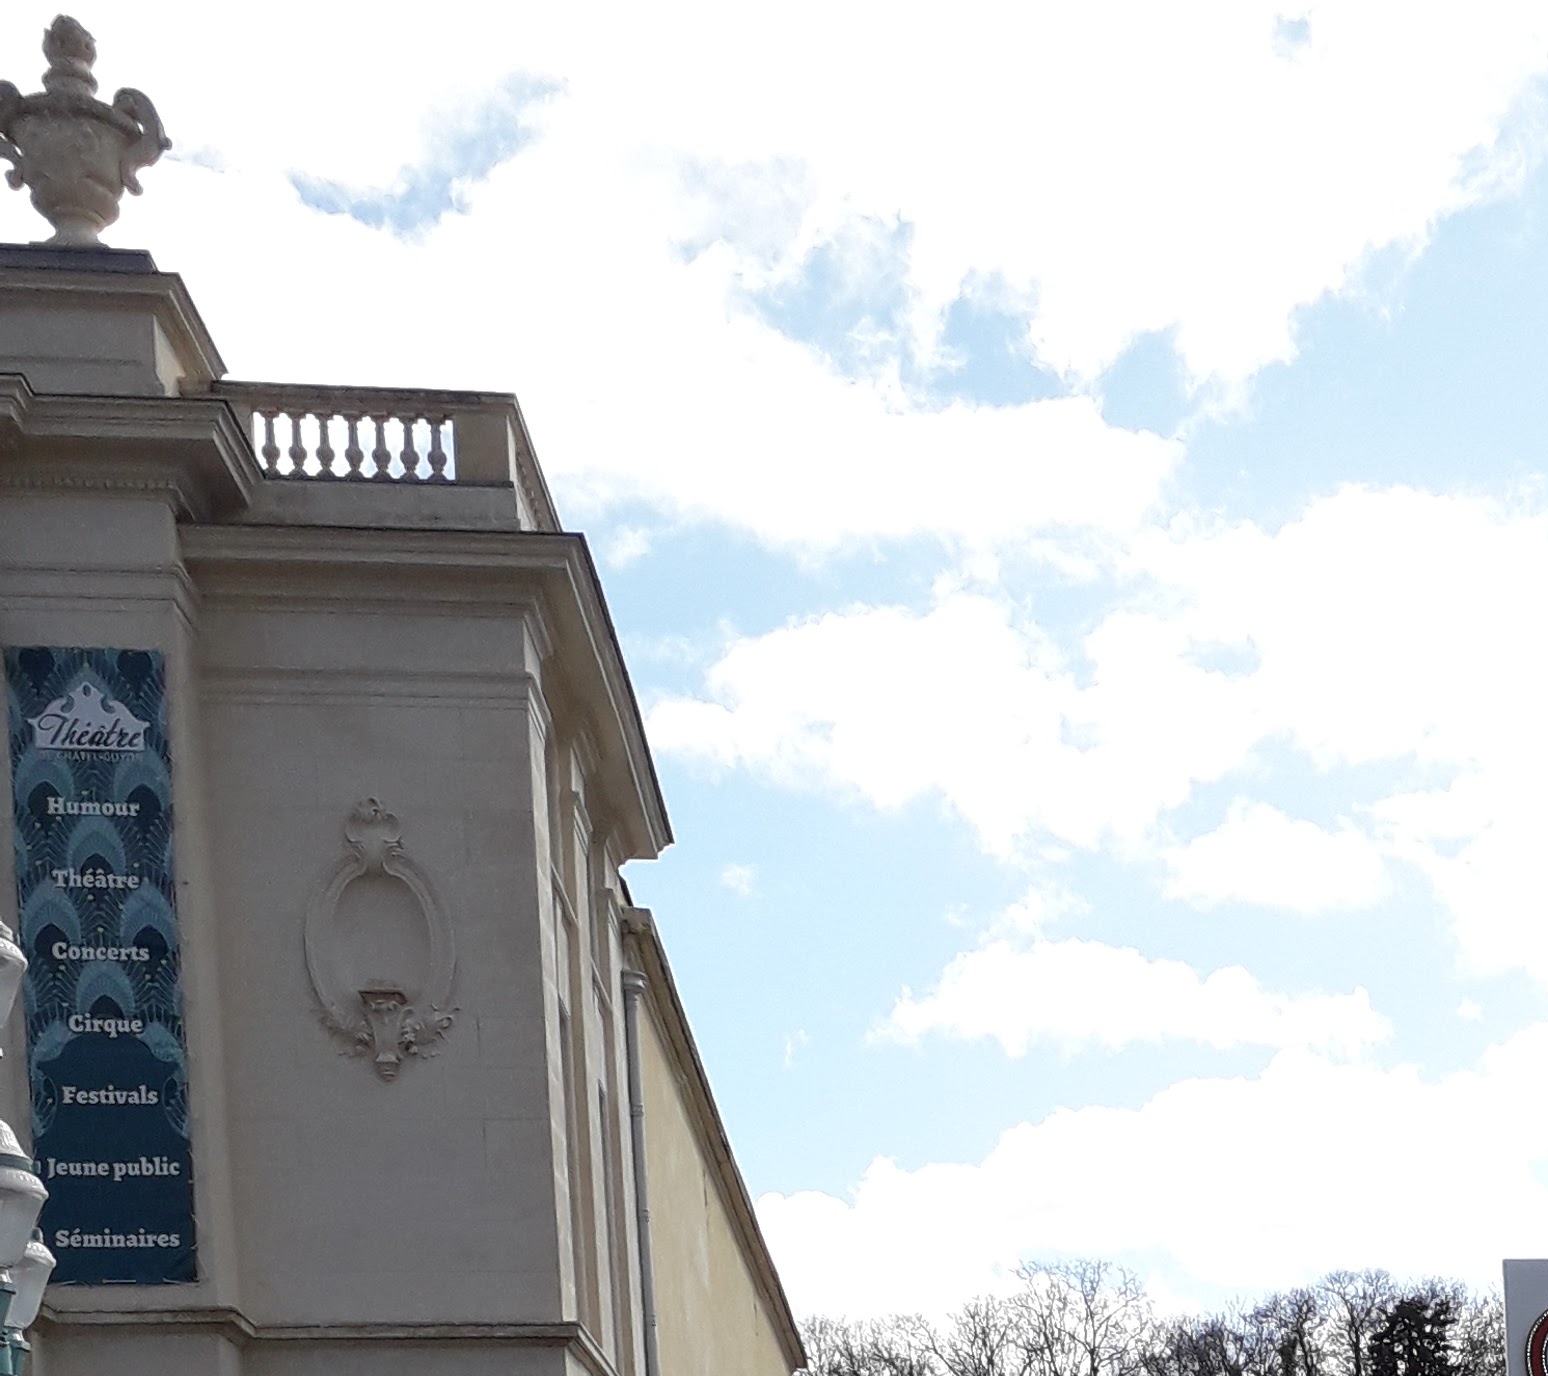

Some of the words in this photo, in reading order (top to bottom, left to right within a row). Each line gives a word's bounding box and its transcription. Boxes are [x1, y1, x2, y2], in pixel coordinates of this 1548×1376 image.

[37, 713, 142, 748] Théâtre
[47, 797, 140, 817] Humour
[51, 868, 140, 889] Théâtre
[52, 942, 150, 961] Concerts
[68, 1014, 143, 1038] Cirque
[62, 1085, 158, 1105] Festivals
[48, 1158, 109, 1178] Jeune
[113, 1157, 180, 1181] public
[55, 1228, 180, 1248] Séminaires
